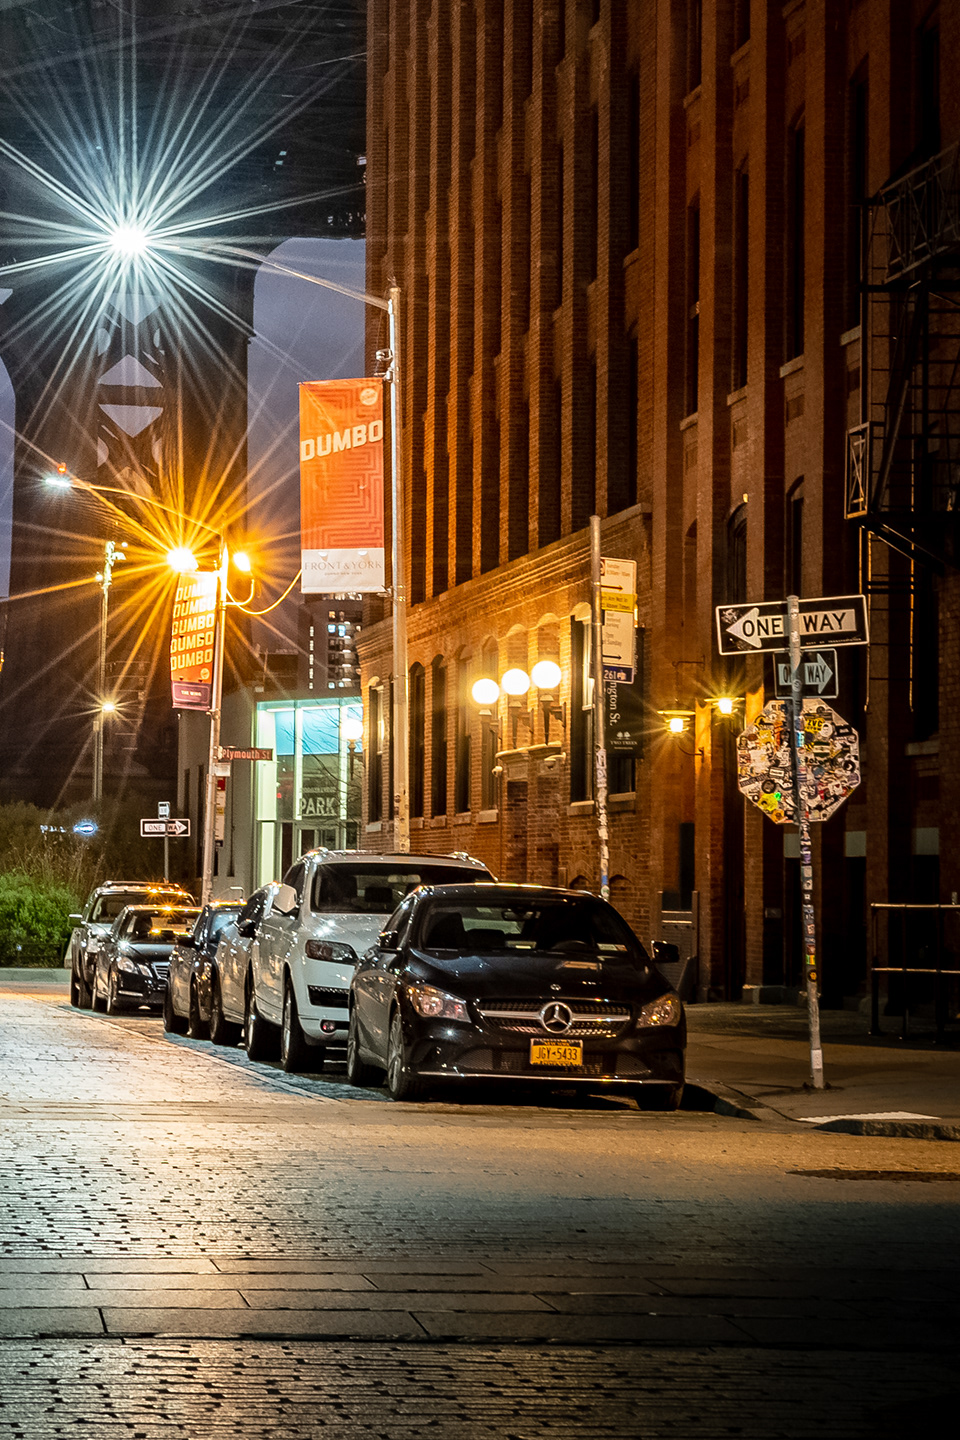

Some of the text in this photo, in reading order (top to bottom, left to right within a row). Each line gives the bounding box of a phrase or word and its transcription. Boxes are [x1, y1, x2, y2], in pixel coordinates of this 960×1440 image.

[301, 419, 384, 462] DUMBO
[742, 612, 846, 637] ONE WAY
[170, 630, 214, 654] DUMBO
[170, 648, 214, 672] DUMBO
[807, 665, 827, 683] WAY
[222, 748, 271, 761] Plymouth St
[299, 797, 335, 815] PARK
